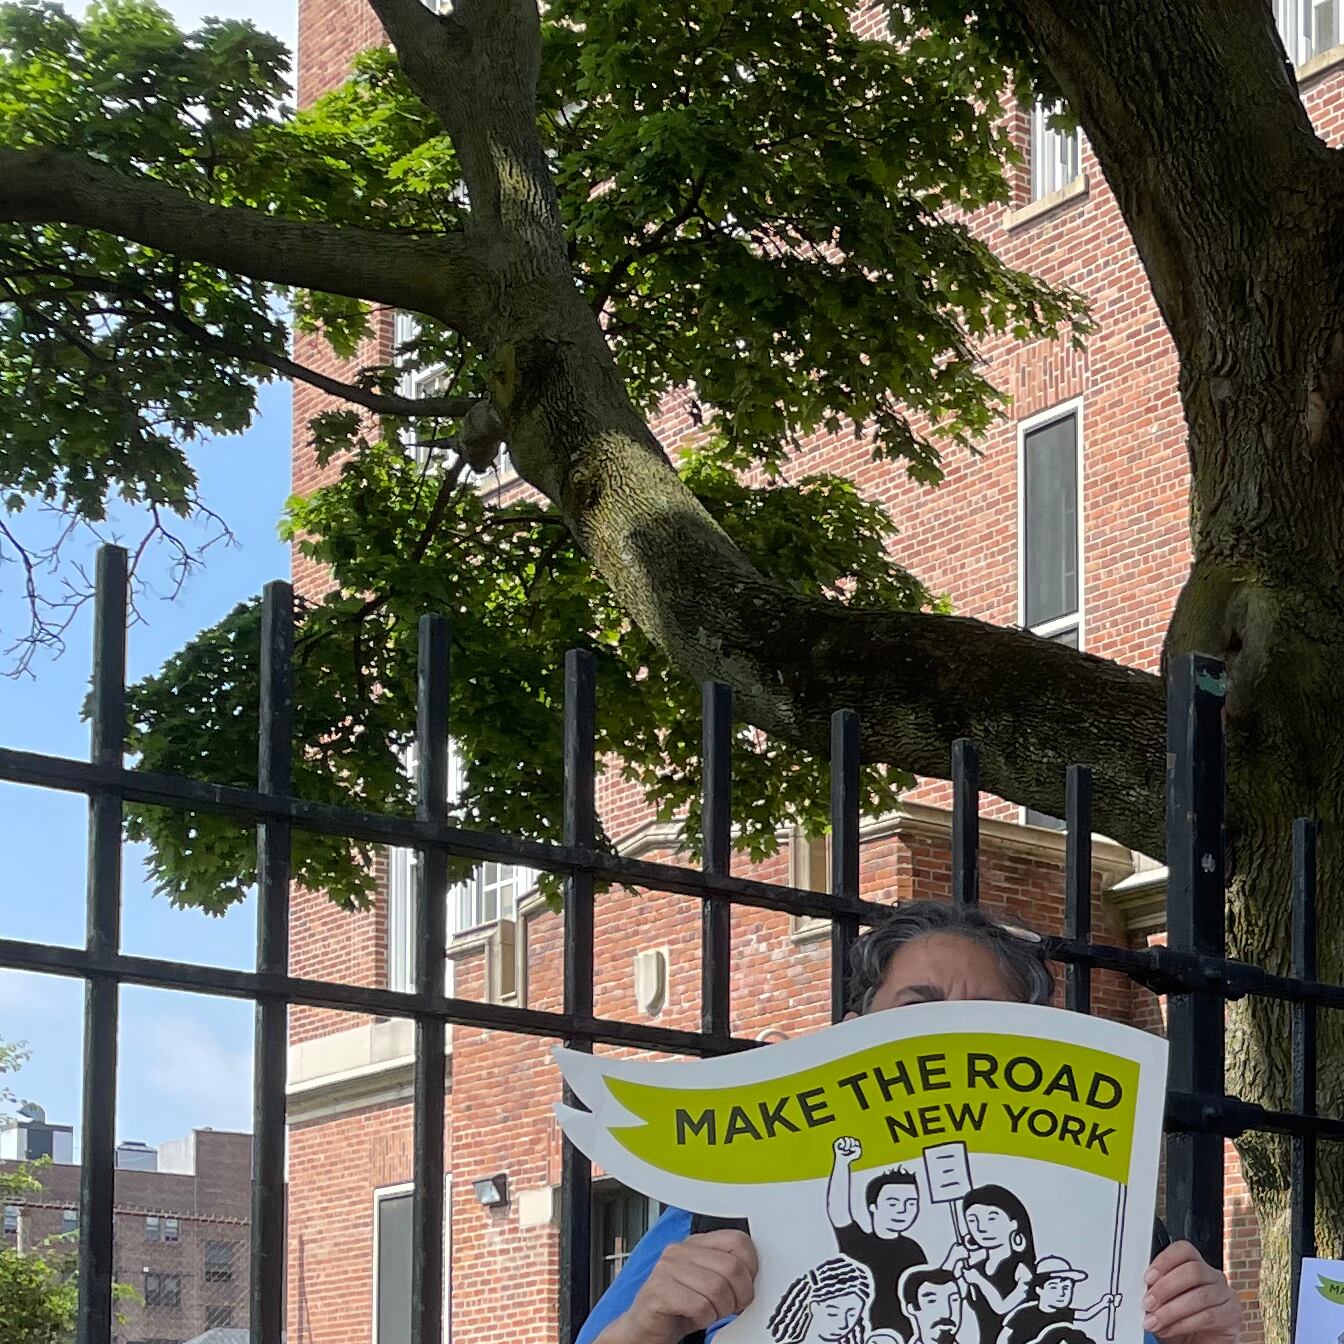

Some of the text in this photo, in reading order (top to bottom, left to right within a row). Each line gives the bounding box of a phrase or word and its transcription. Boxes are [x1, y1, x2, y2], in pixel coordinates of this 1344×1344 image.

[675, 1051, 1123, 1146] MAKE THE ROAD
[884, 1102, 1118, 1156] NEW YORK
